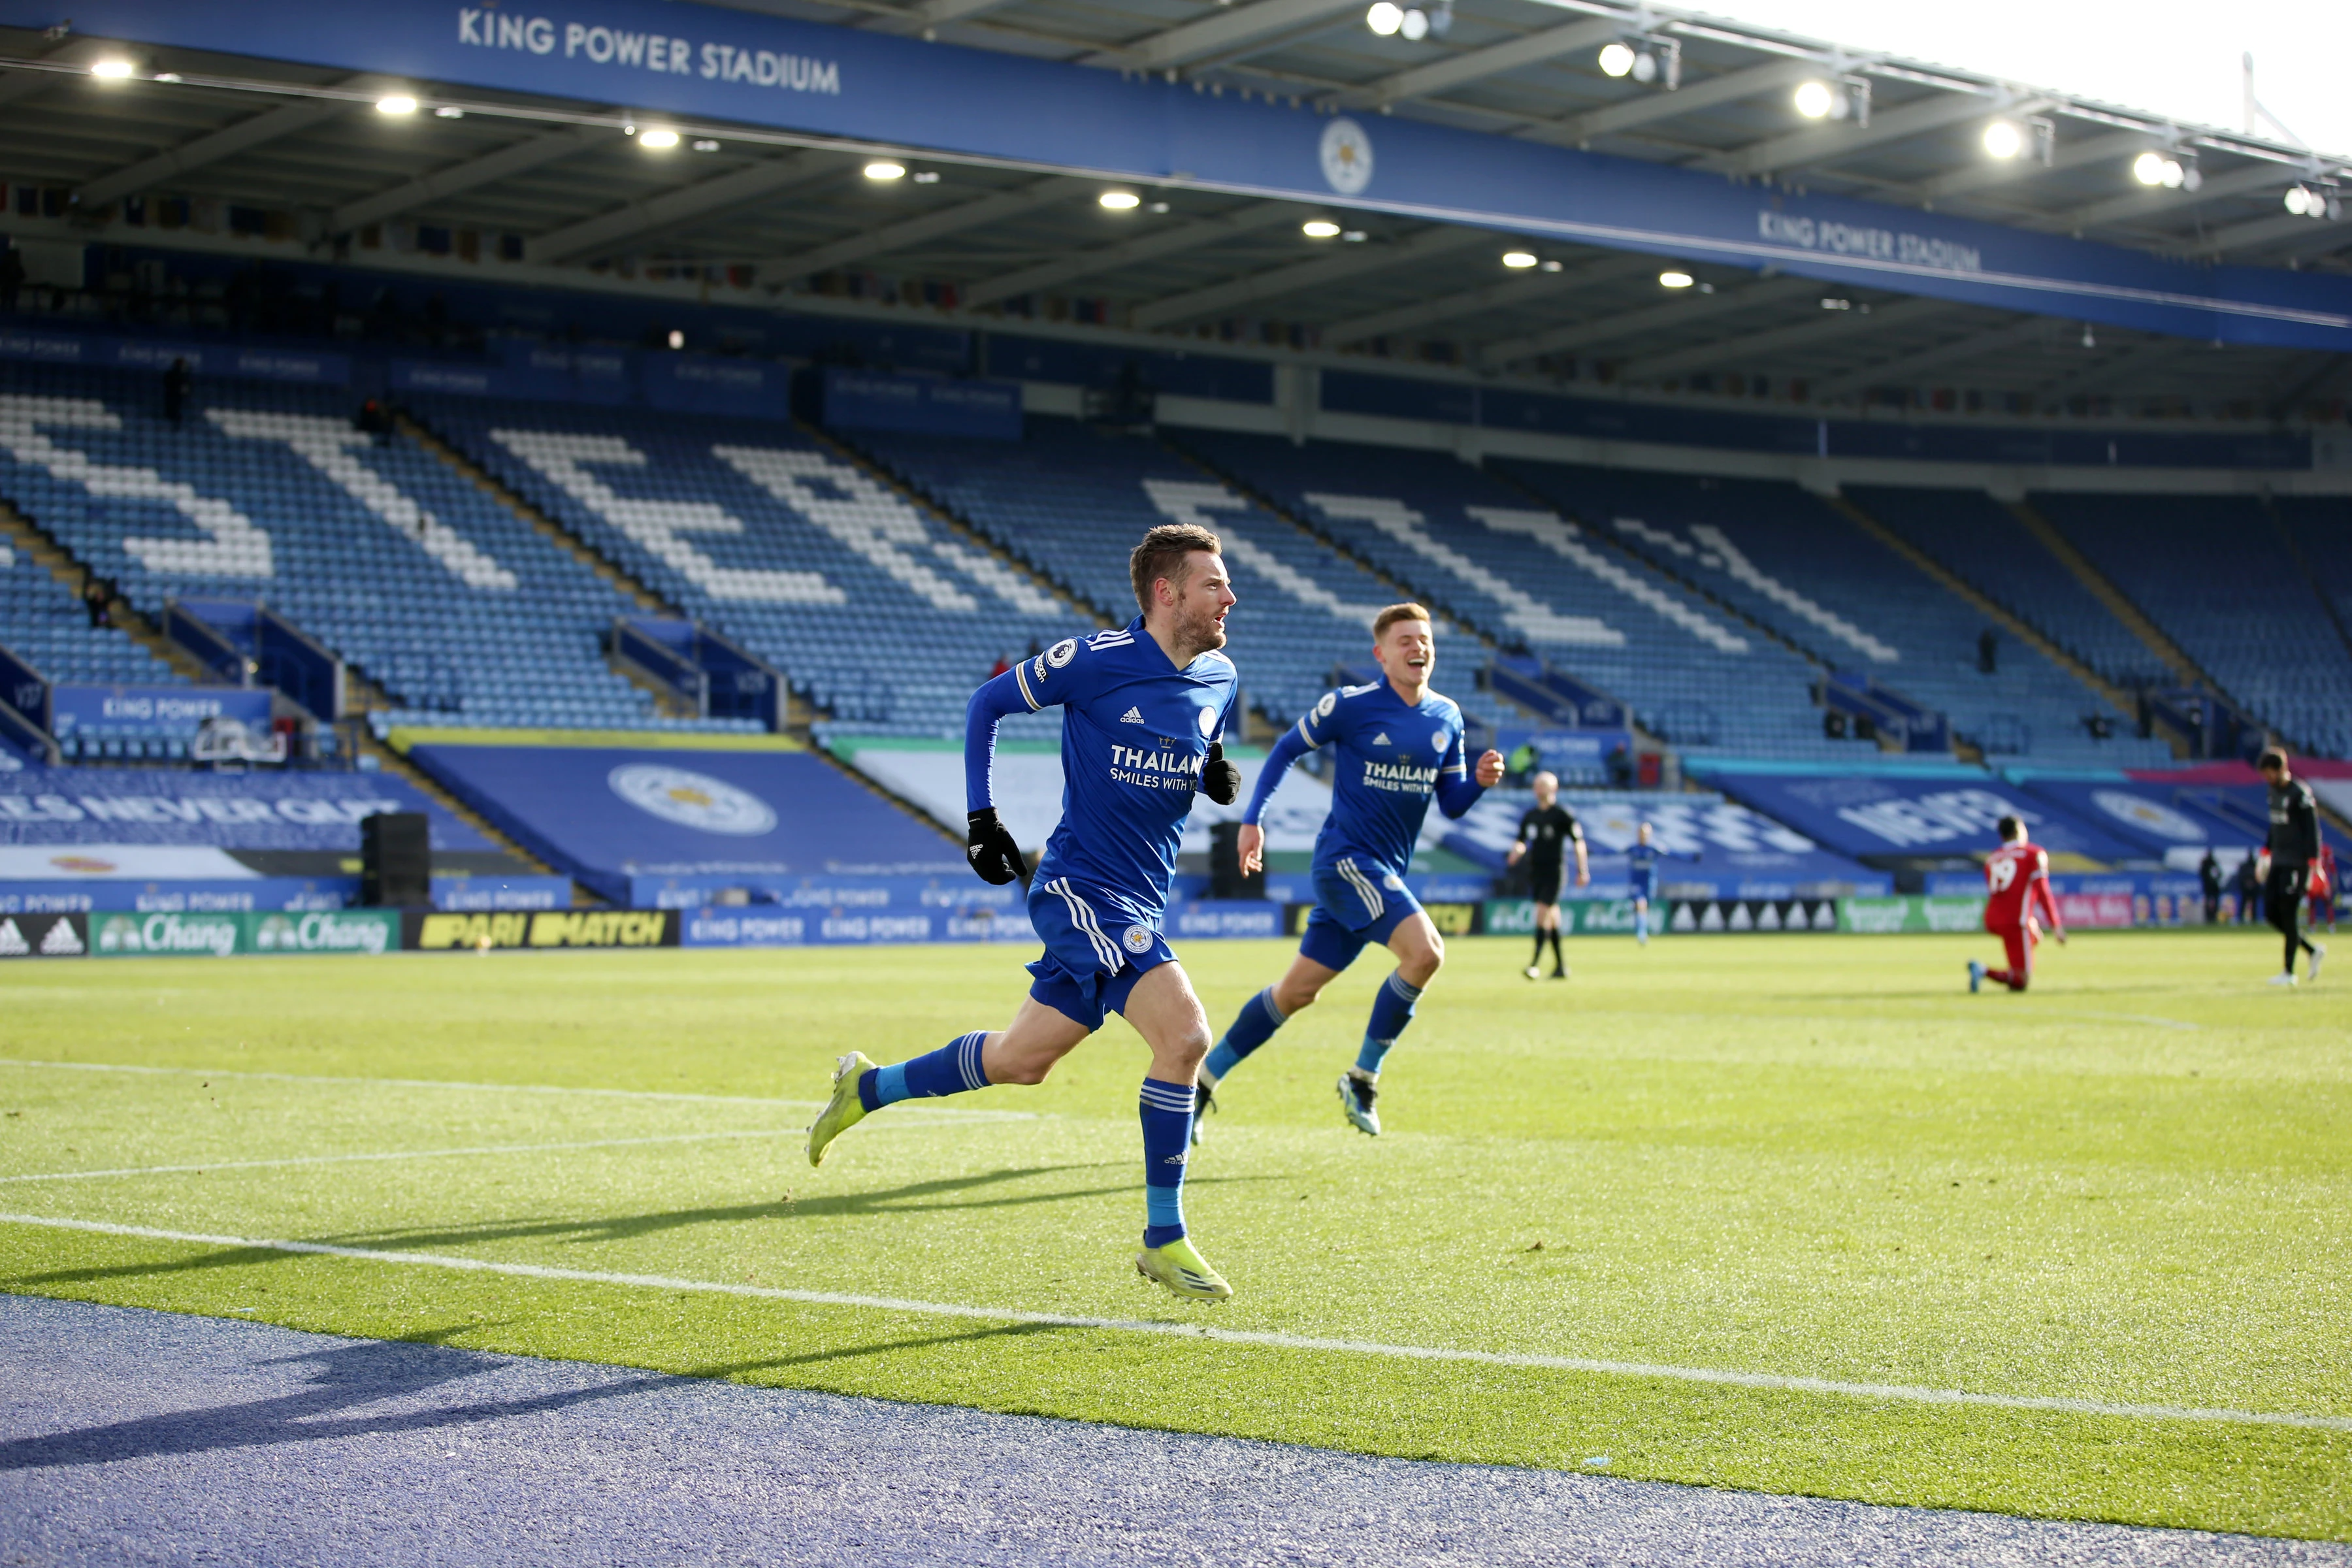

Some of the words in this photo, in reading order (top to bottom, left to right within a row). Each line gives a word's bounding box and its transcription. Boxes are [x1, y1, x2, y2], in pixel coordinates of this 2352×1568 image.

[459, 8, 555, 55] KING
[565, 22, 691, 75] POWER
[700, 42, 840, 95] STADIUM
[1759, 212, 1815, 248] KING
[1820, 222, 1893, 257] POWER
[1899, 233, 1982, 272] STADIUM
[103, 698, 154, 719] KING
[155, 698, 222, 719] POWER
[1110, 768, 1160, 789] SMILES
[1163, 777, 1187, 791] WITH
[1189, 779, 1198, 791] YO
[1363, 776, 1399, 792] SMILES
[1401, 783, 1422, 793] WITH
[188, 892, 255, 913] POWER
[142, 913, 237, 957] Chang
[298, 913, 388, 956] Chang
[419, 913, 527, 949] PARI
[529, 912, 666, 947] MATCH
[690, 917, 740, 941] KING
[741, 917, 805, 940] POWER
[821, 917, 868, 939] KING
[870, 916, 931, 939] POWER
